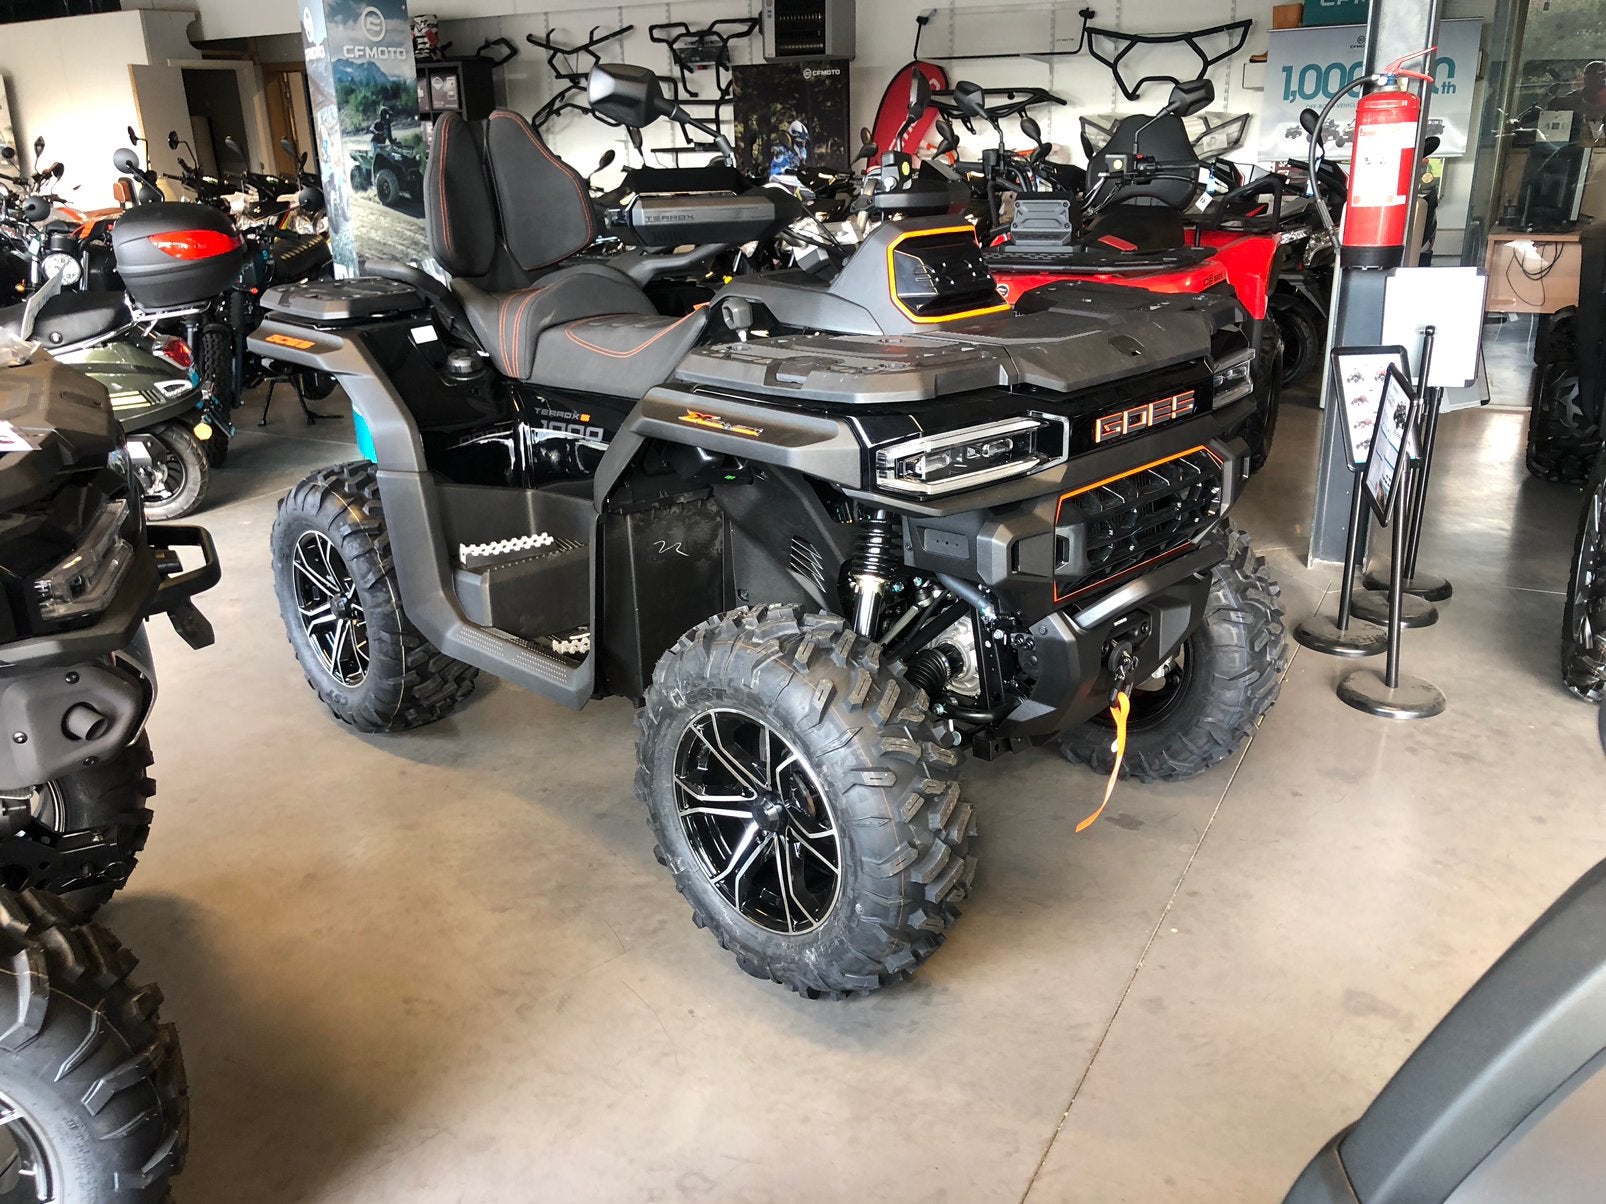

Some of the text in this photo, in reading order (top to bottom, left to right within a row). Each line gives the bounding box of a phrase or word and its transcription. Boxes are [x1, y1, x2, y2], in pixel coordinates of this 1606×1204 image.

[343, 45, 406, 60] CFMOTO
[812, 69, 841, 77] CFMOTO
[534, 407, 580, 421] TERROX
[1095, 389, 1196, 444] GOES
[540, 419, 605, 442] 1000
